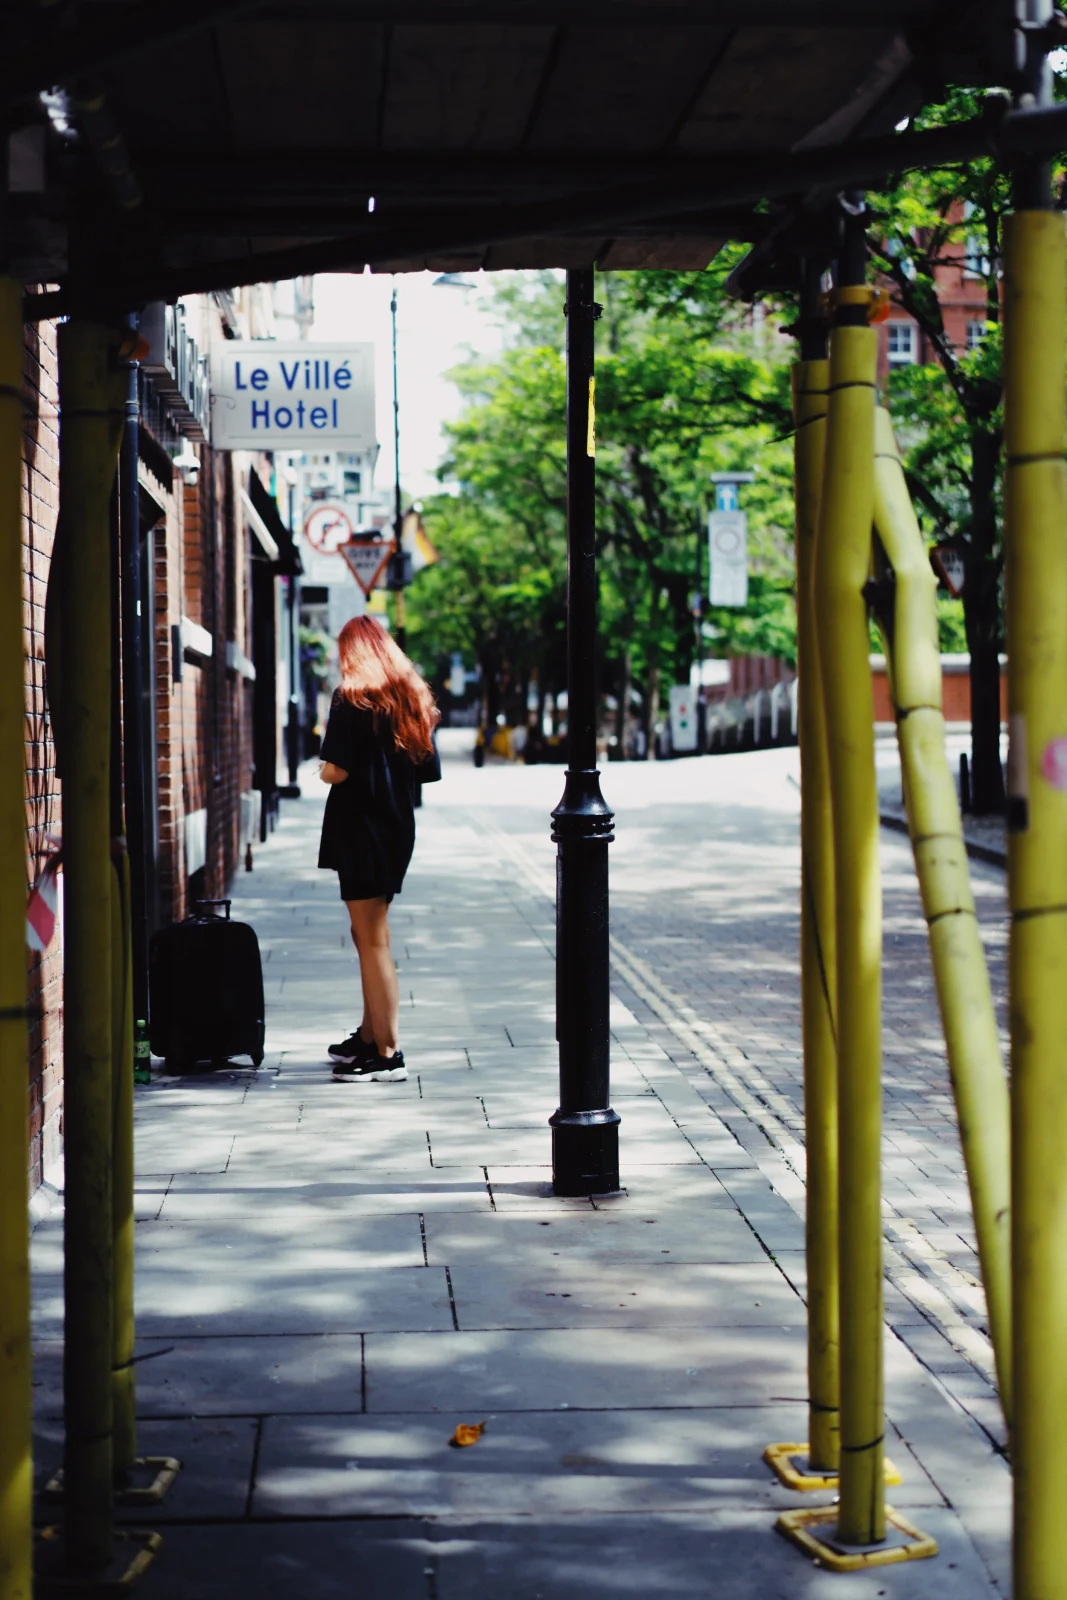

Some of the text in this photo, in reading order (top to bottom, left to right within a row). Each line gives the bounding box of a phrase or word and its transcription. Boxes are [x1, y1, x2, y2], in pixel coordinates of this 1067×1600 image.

[235, 360, 353, 391] Le Villé
[250, 398, 338, 429] Hotel
